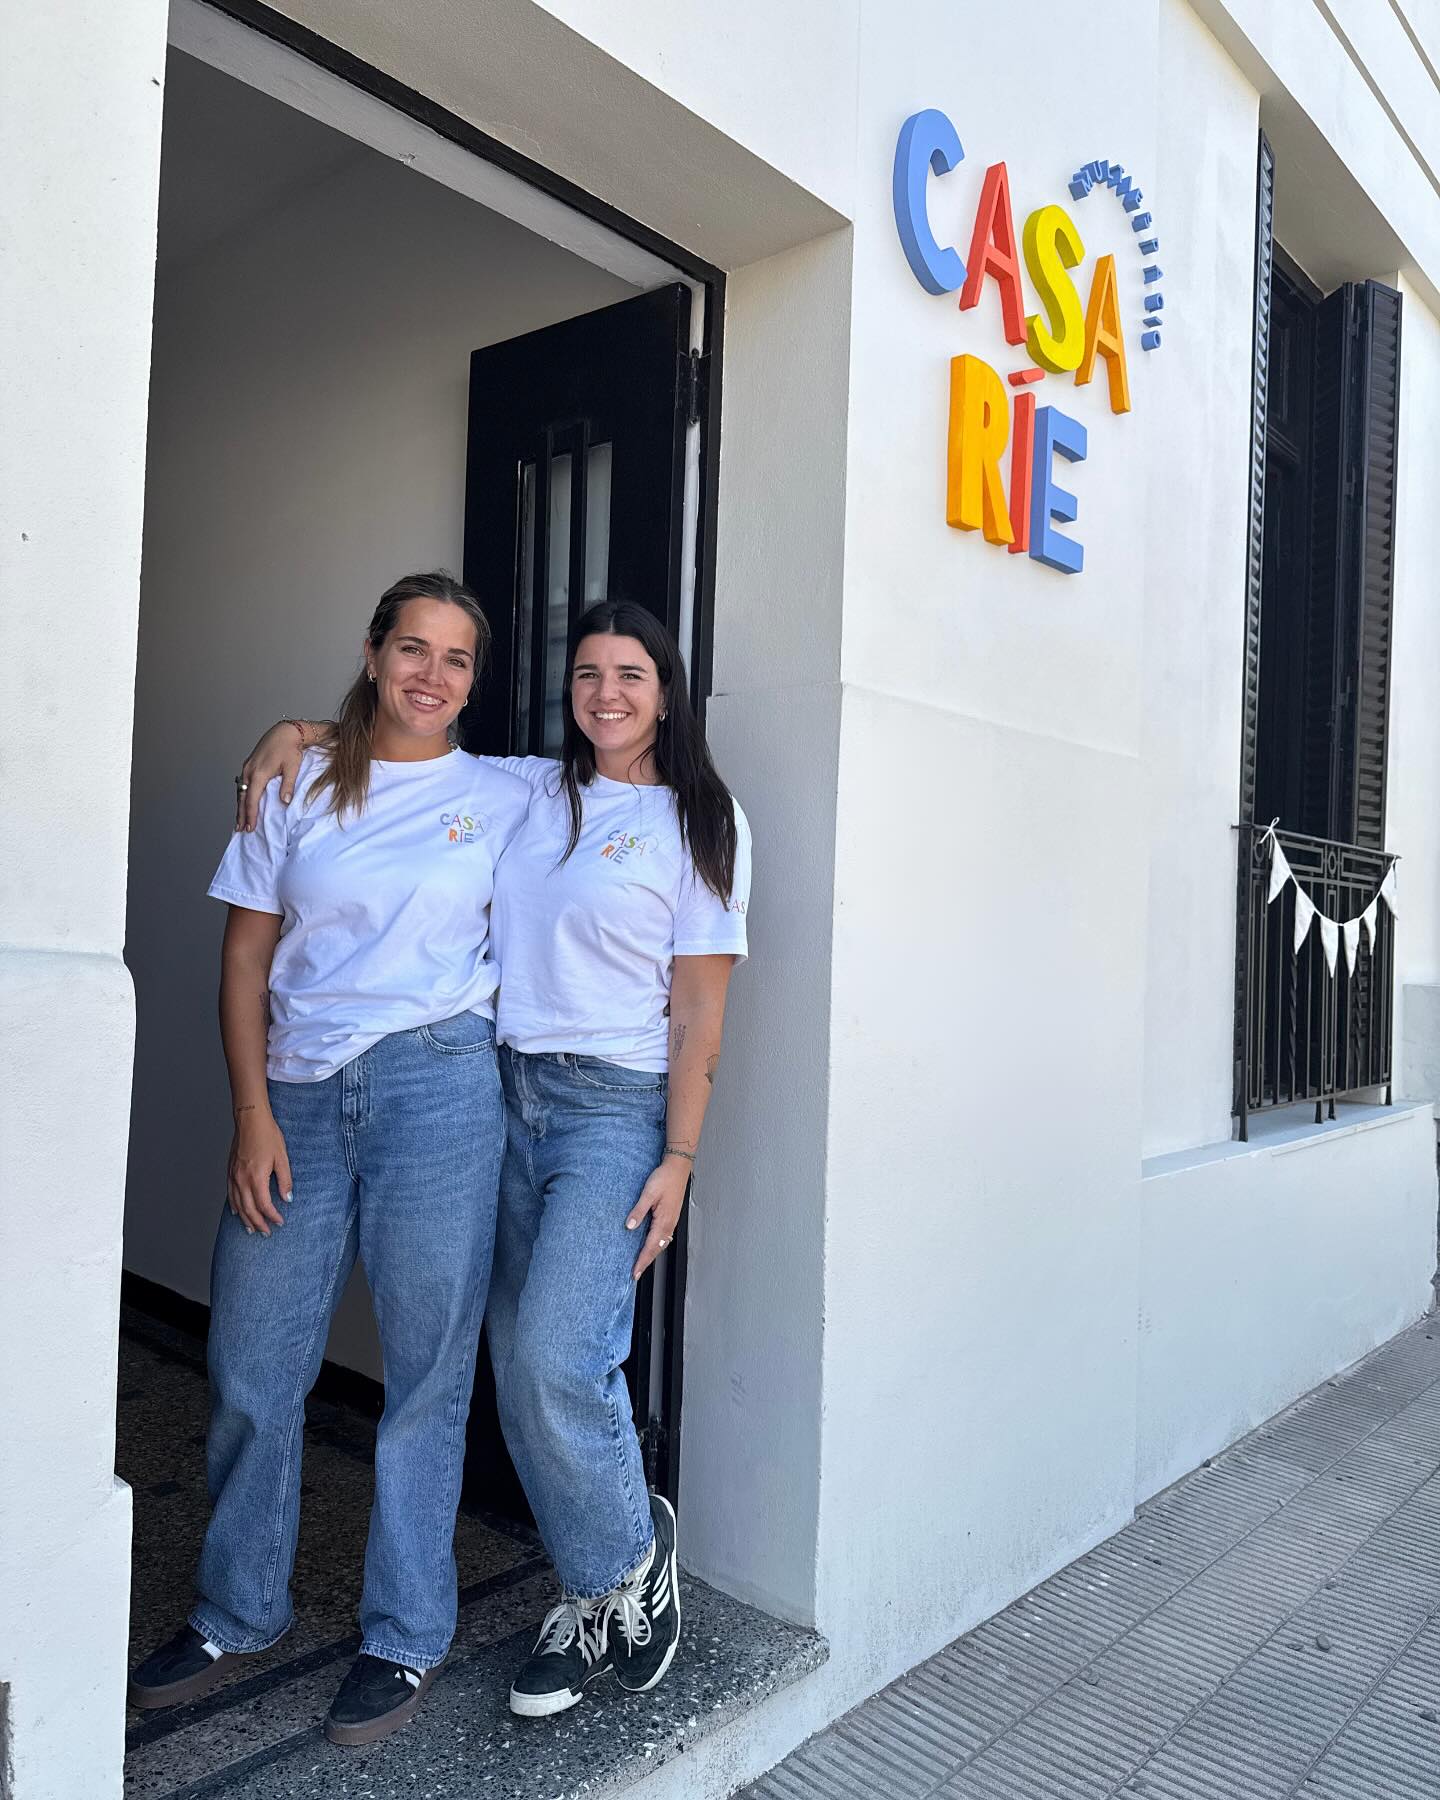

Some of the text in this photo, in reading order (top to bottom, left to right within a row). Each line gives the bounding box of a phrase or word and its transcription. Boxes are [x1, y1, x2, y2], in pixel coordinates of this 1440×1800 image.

[892, 108, 1131, 415] CASA
[946, 353, 1087, 575] RÍE
[440, 813, 485, 832] CASA
[607, 829, 647, 856] CASA
